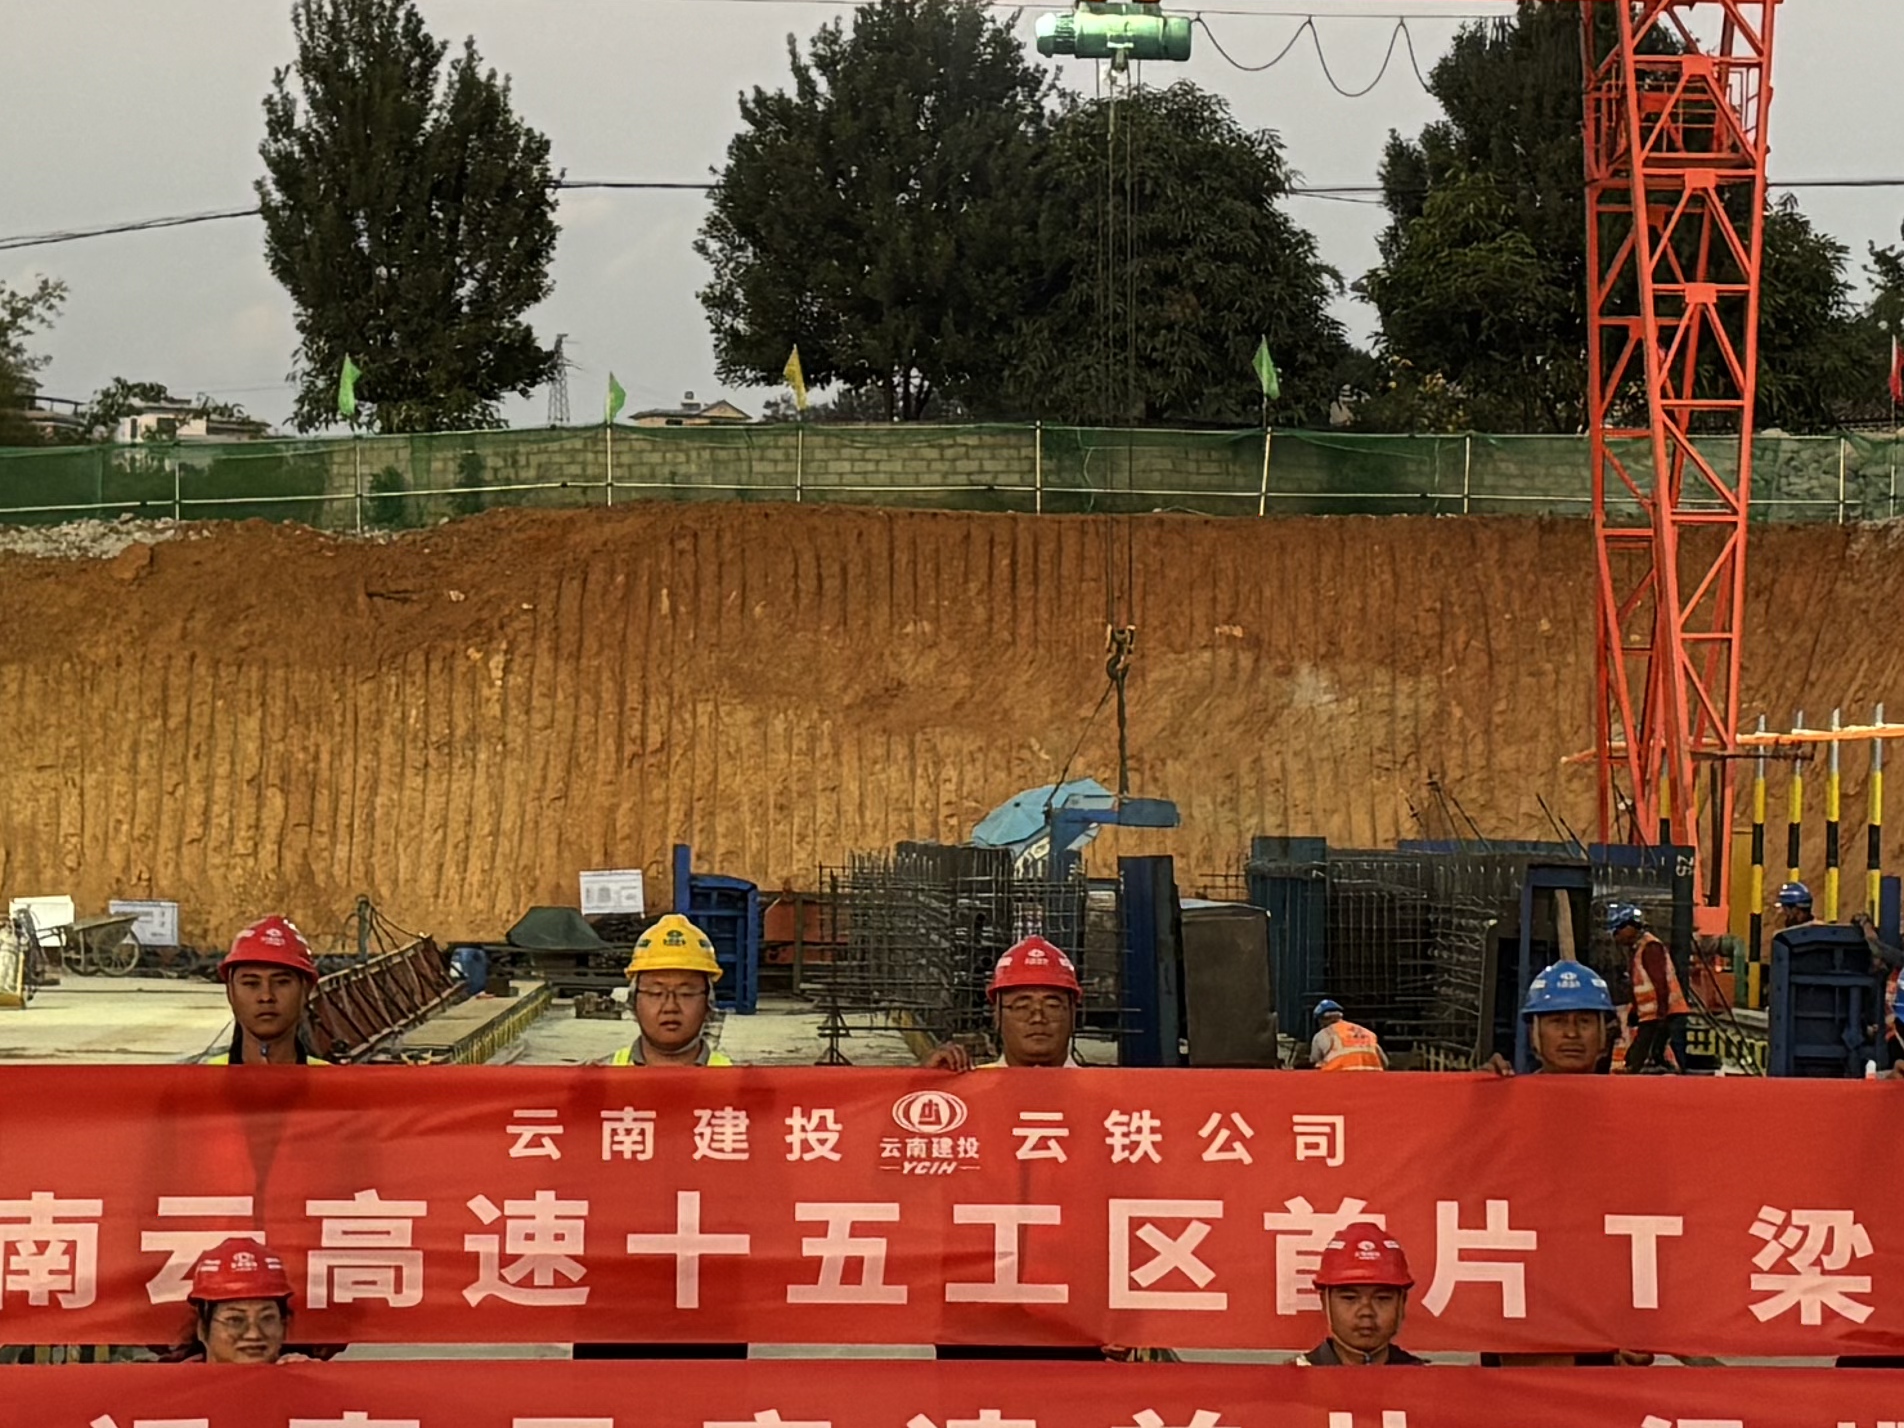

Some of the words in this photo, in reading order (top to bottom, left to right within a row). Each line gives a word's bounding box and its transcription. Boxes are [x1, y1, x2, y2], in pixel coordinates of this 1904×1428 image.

[505, 1106, 844, 1162] 云南建投
[879, 1136, 981, 1159] 云南建投
[1011, 1109, 1345, 1168] 云铁公司
[902, 1160, 959, 1175] YCIH
